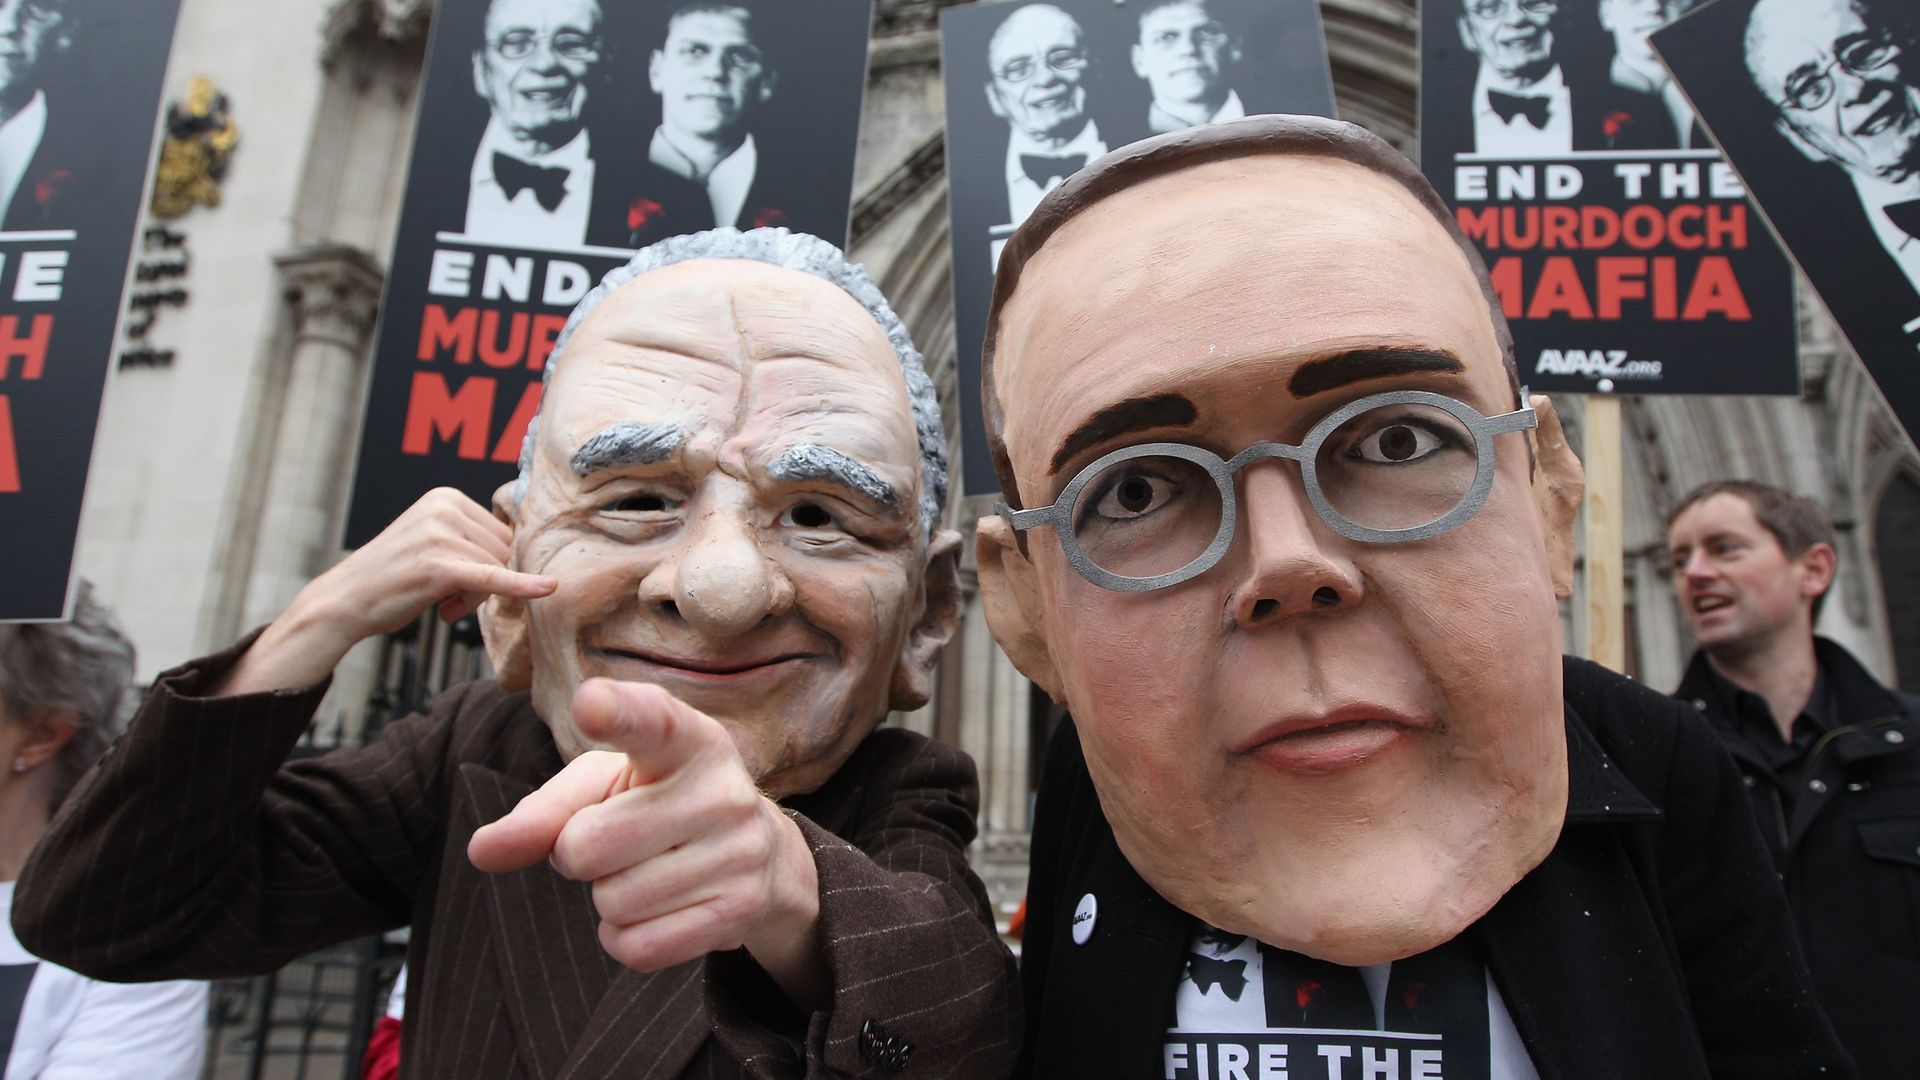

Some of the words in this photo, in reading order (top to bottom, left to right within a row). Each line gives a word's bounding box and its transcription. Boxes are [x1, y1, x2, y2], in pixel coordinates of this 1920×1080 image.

[1455, 163, 1583, 200] END
[1614, 162, 1747, 199] THE
[1456, 204, 1748, 250] MURDOCH
[427, 249, 592, 306] END
[1163, 1043, 1289, 1080] FIRE
[1317, 1044, 1443, 1080] THE
